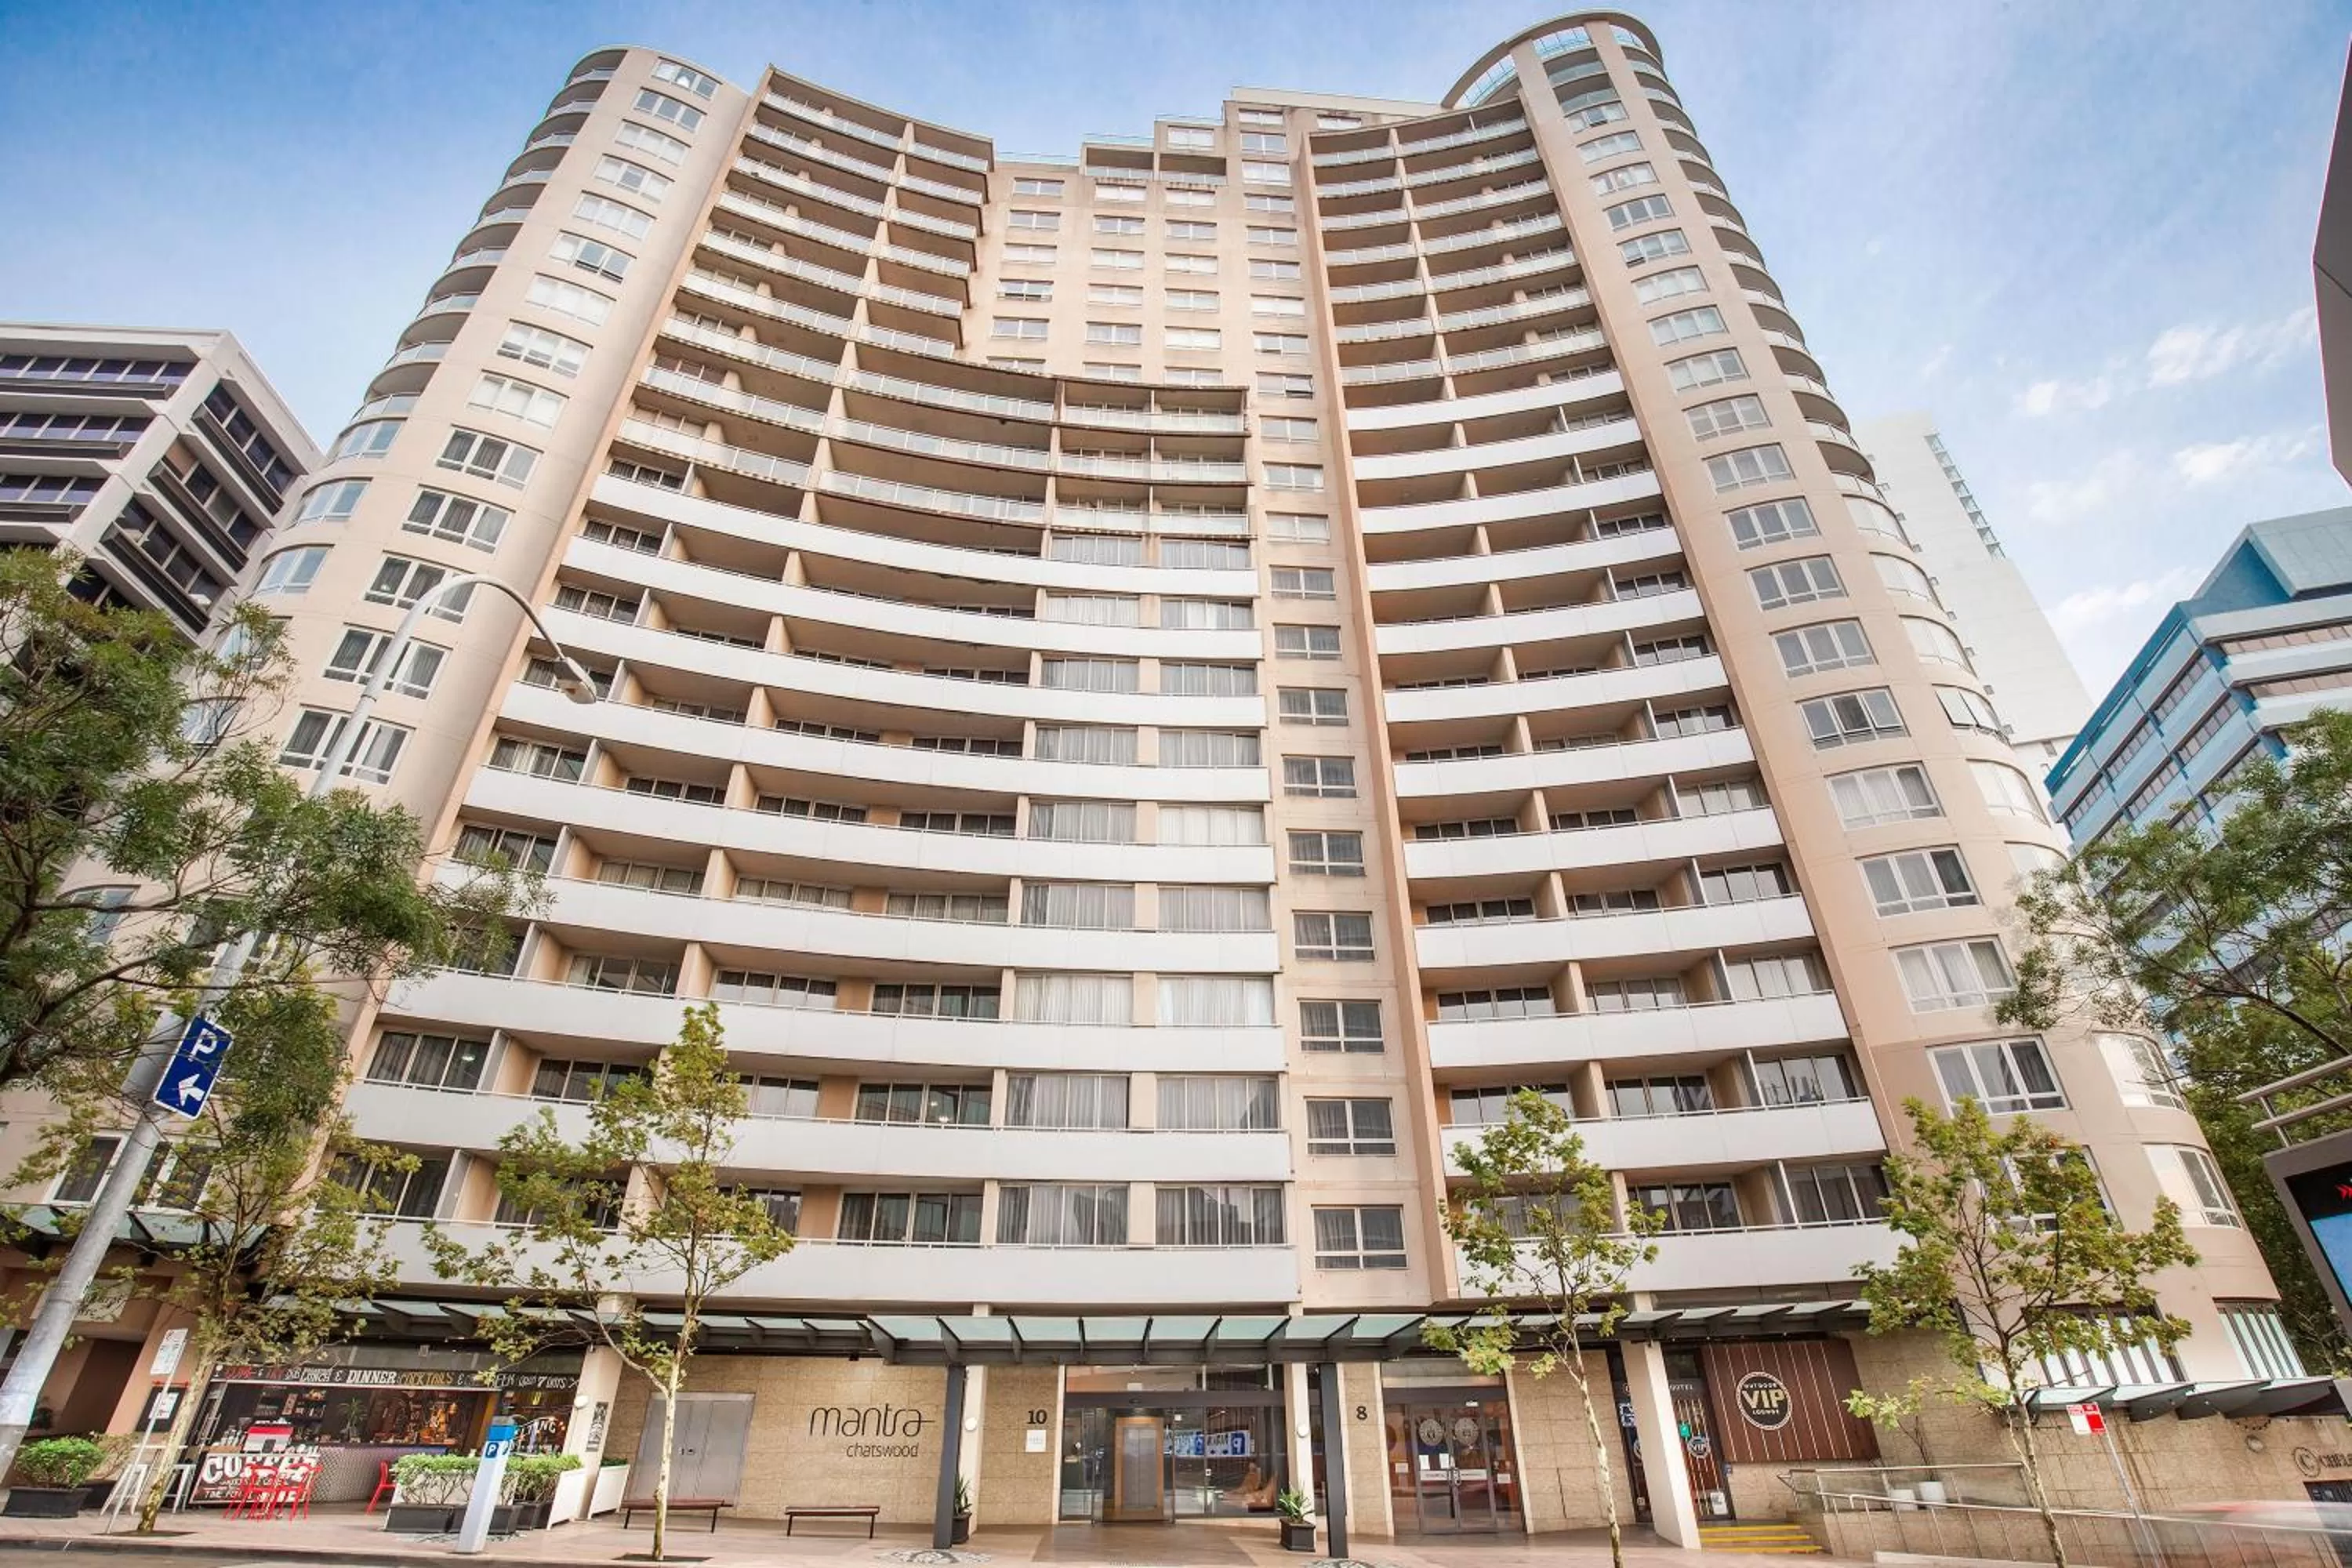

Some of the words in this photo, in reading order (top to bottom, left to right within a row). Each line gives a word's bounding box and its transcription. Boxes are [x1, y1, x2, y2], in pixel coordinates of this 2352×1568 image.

[187, 1028, 218, 1062] P
[345, 1370, 397, 1384] DINNER
[536, 1375, 547, 1388] 7
[1741, 1388, 1785, 1409] VIP
[809, 1403, 936, 1437] mantra
[1026, 1409, 1048, 1425] 10
[1356, 1406, 1368, 1421] 8
[488, 1443, 497, 1456] P
[846, 1443, 920, 1457] chatswood
